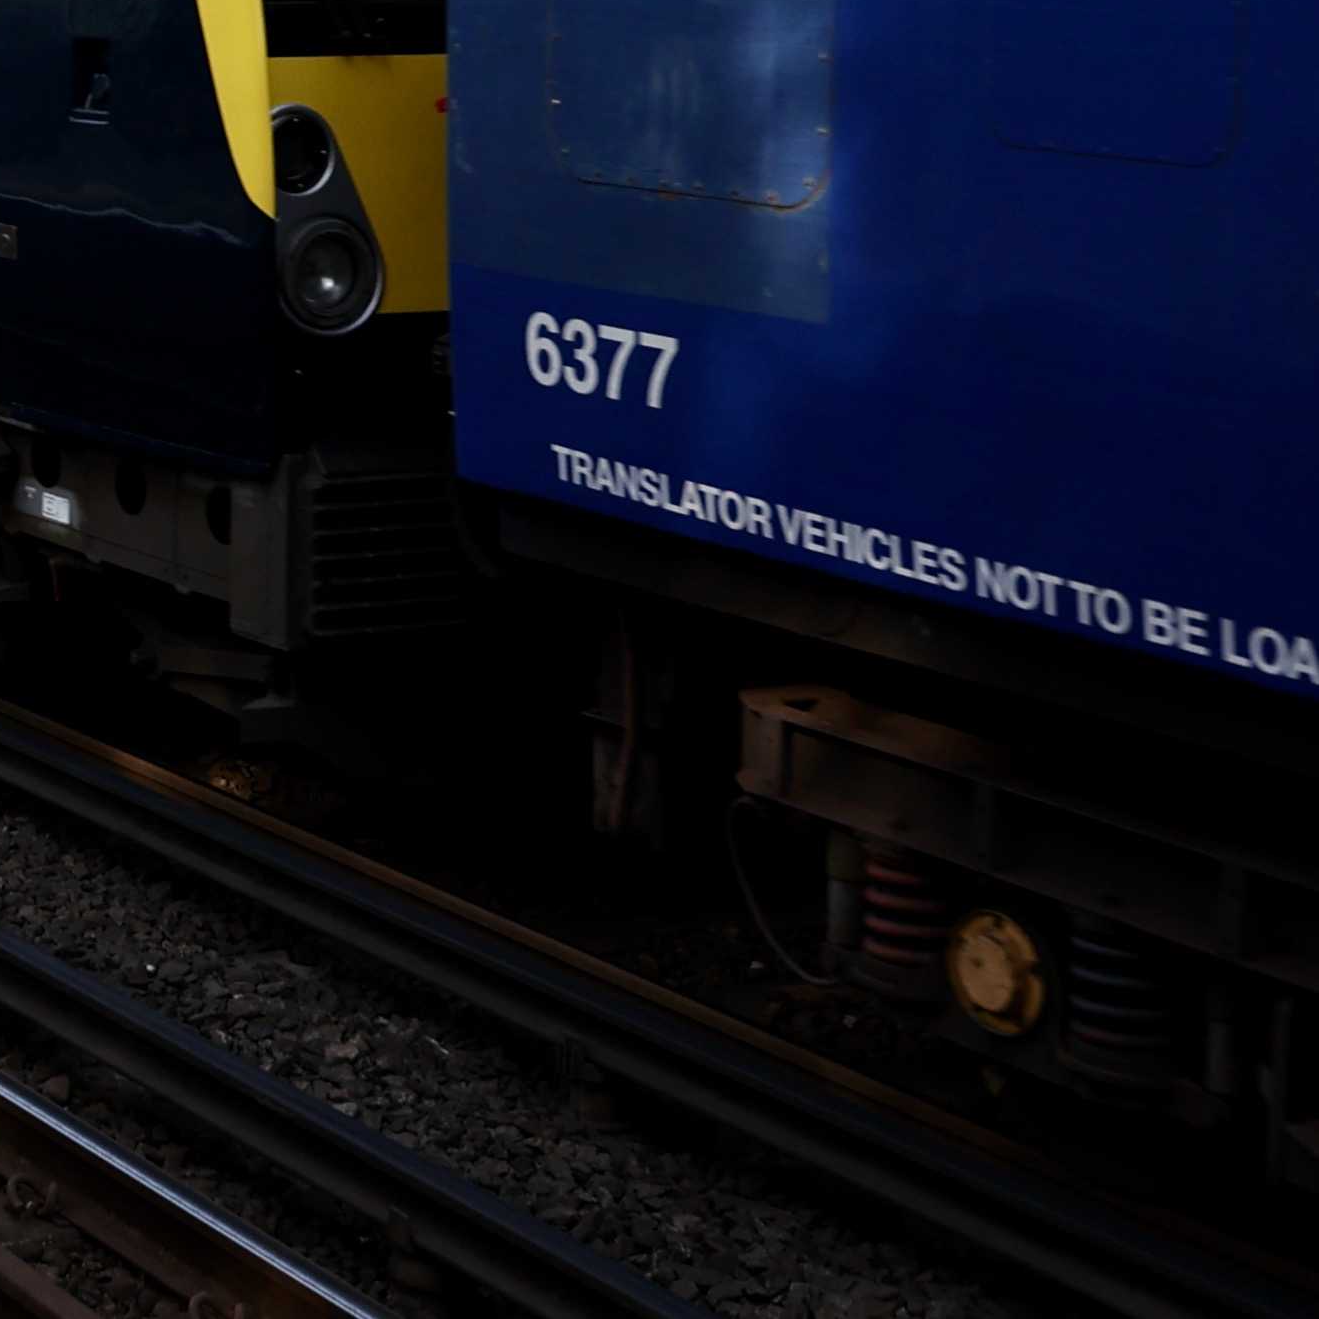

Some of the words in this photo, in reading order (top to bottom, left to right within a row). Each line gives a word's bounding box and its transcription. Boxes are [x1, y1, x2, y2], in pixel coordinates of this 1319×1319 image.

[524, 311, 680, 409] 6377
[550, 443, 774, 540] TRANSLATOR
[775, 503, 969, 593] VEHICLES
[974, 556, 1064, 617] NOT
[1066, 578, 1132, 635] TO
[1141, 598, 1212, 657] BE
